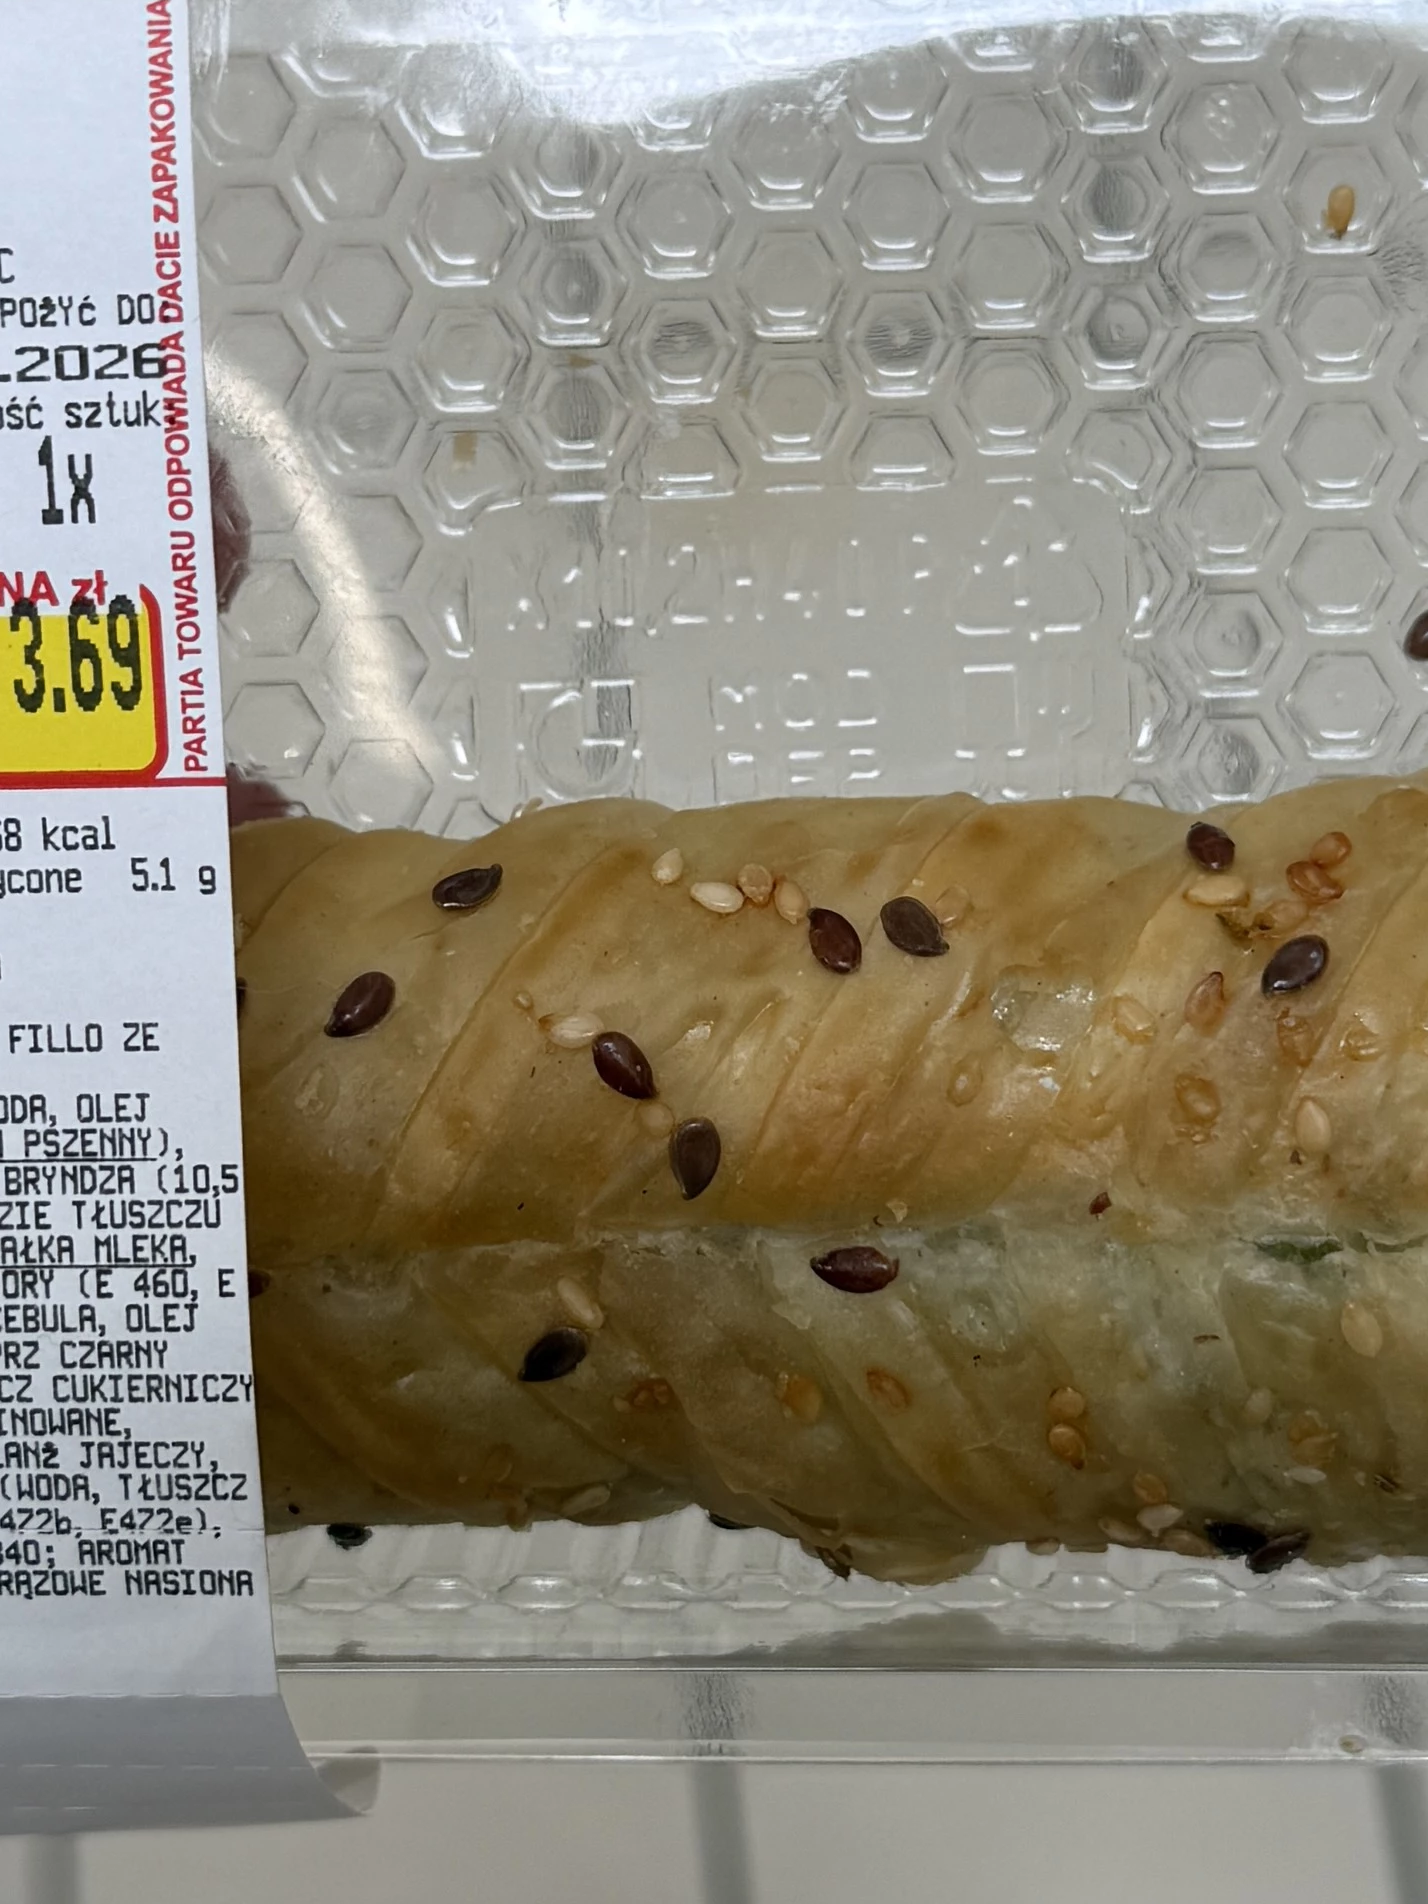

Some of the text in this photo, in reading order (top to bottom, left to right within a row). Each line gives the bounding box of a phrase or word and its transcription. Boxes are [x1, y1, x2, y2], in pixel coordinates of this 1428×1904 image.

[154, 231, 185, 324] DACIE
[159, 331, 194, 521] ODPOWIADA
[38, 435, 96, 525] 1x
[71, 570, 108, 606] zł
[169, 531, 202, 660] TOWARU
[9, 594, 143, 714] 3.69
[179, 668, 208, 772] PARTIA
[42, 816, 115, 851] kcal
[131, 857, 176, 891] 5.1
[199, 866, 216, 895] g
[9, 1023, 103, 1054] FILLO
[123, 1022, 159, 1052] ZE
[77, 1093, 150, 1123] OLEJ
[24, 1127, 183, 1163] PSZENNY),
[4, 1165, 135, 1196] BRYNDZA
[53, 1372, 253, 1406] CUKIERNICZY
[78, 1537, 185, 1571] AROMAT
[125, 1569, 254, 1596] NASIONA
